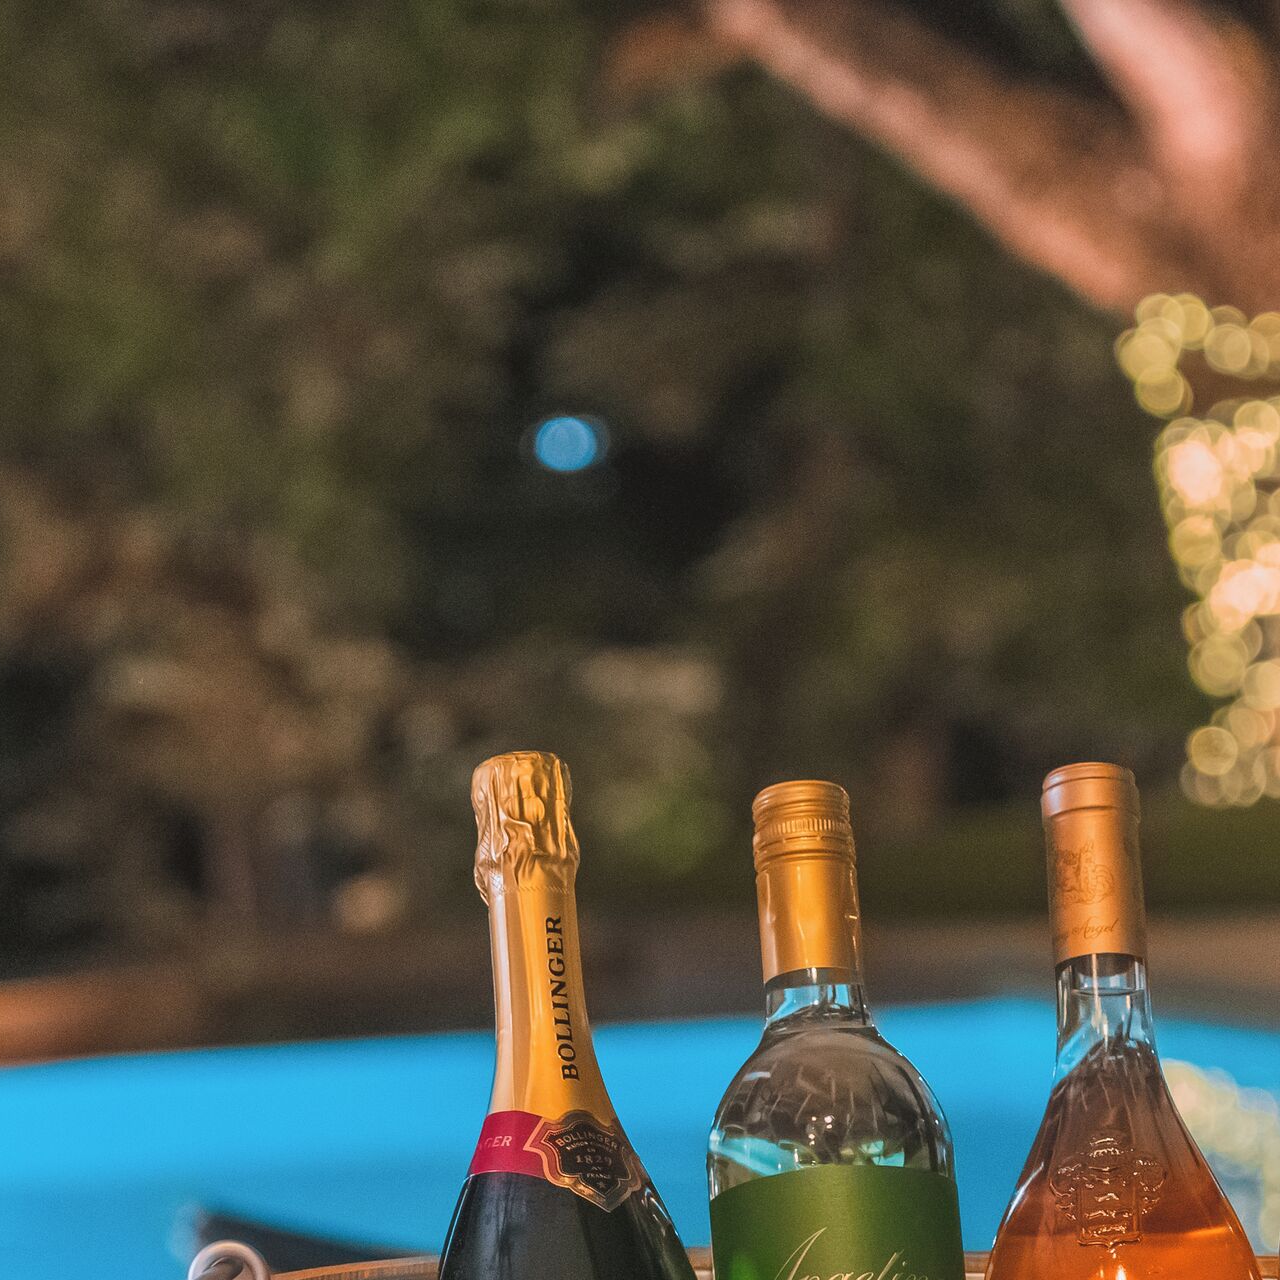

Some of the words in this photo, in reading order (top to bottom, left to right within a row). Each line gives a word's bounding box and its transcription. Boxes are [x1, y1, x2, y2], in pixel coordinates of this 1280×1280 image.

[545, 916, 580, 1081] BOLLINGER
[555, 1131, 618, 1151] BOLLINGER
[575, 1154, 613, 1166] 1829
